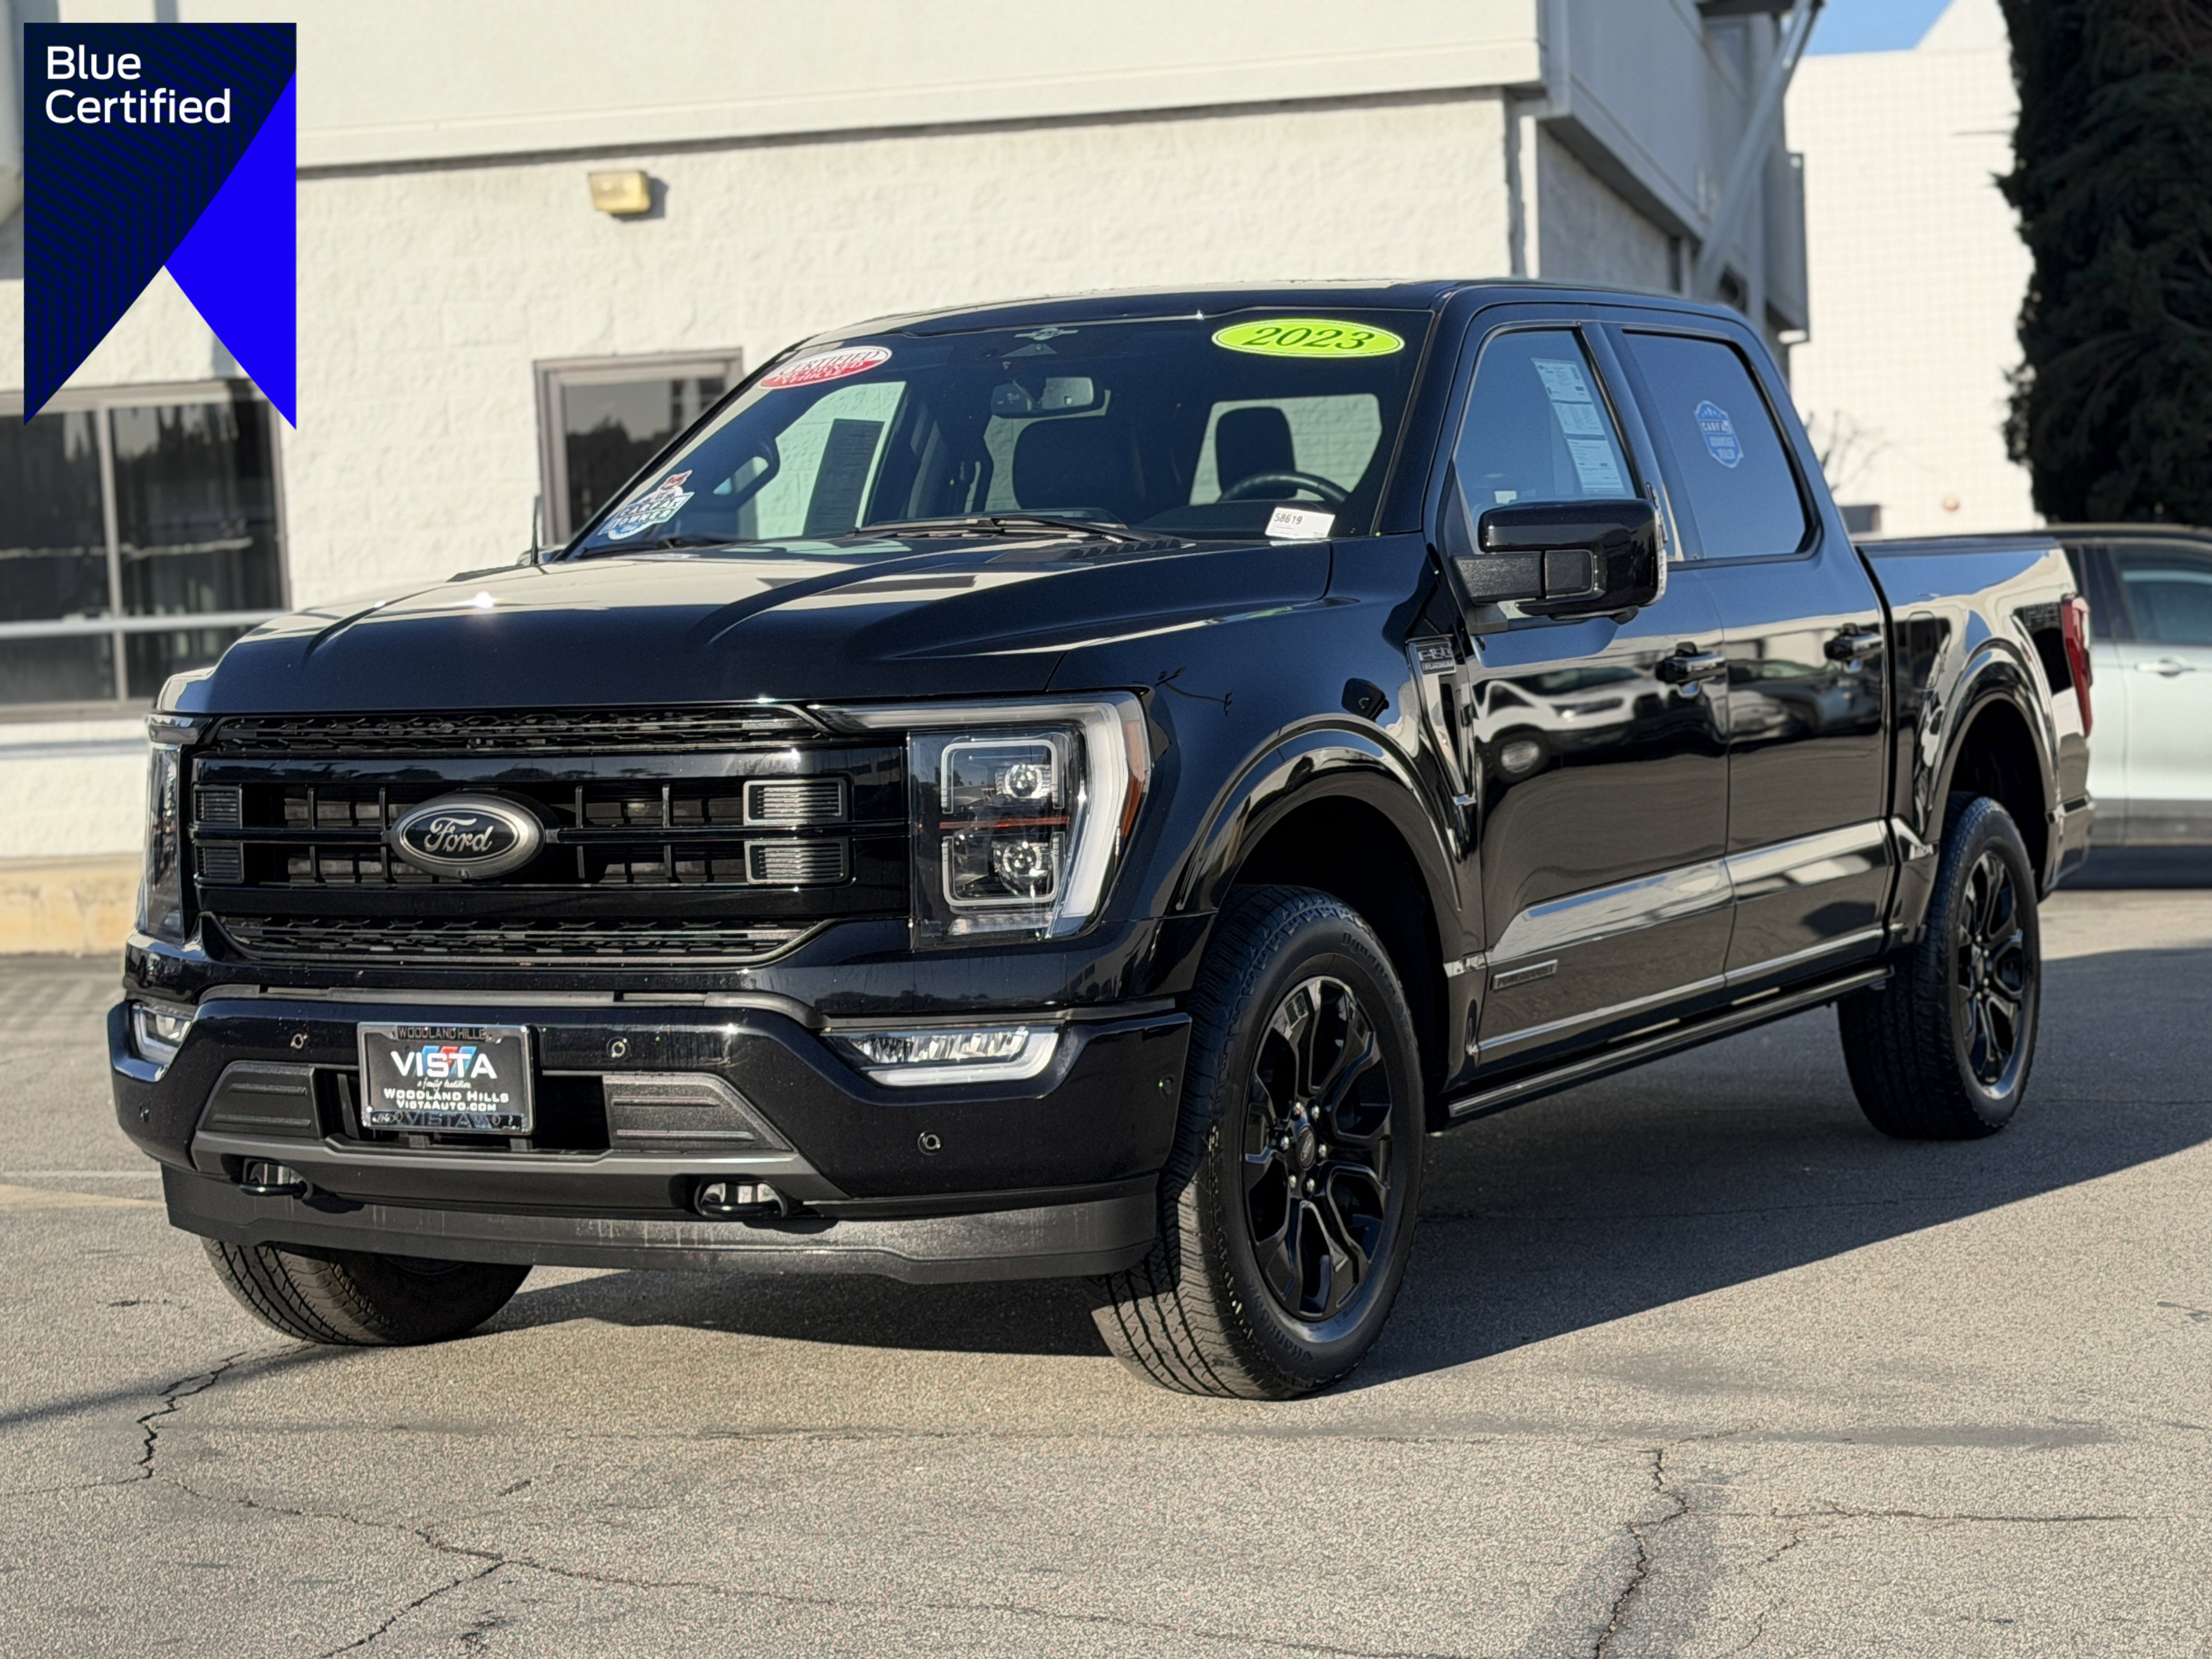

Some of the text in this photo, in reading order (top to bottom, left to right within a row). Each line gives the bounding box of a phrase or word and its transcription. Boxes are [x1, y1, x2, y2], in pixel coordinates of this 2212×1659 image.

[1242, 327, 1375, 349] 2023
[779, 351, 881, 375] CERTIFIED
[1274, 513, 1303, 525] 58619
[424, 817, 494, 852] Ford
[399, 1026, 456, 1039] WOODLAND
[390, 1051, 498, 1079] VISTA
[384, 1088, 509, 1103] WOODLAND HILLS
